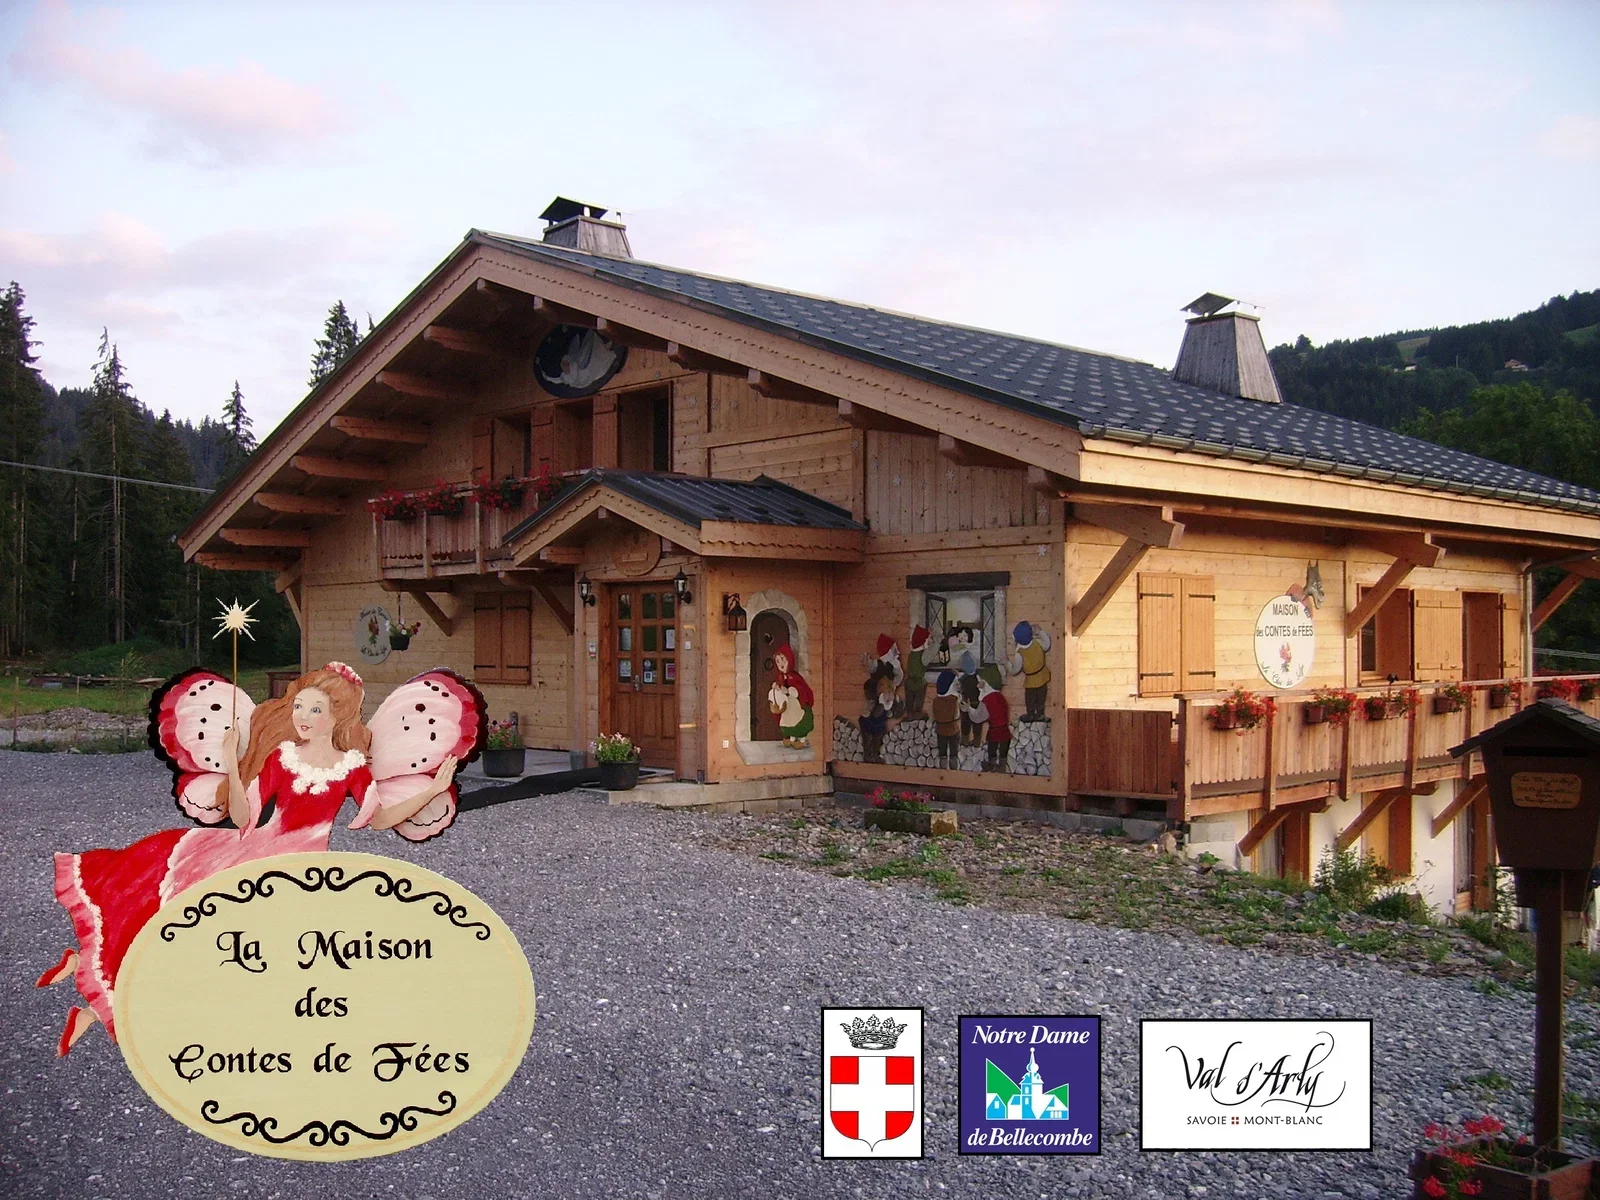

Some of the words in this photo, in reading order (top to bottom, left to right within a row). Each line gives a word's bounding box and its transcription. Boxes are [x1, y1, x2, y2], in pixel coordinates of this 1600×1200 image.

[1272, 603, 1299, 616] MAISON
[1256, 626, 1264, 637] des
[1264, 625, 1291, 637] CONTES
[1292, 626, 1298, 637] de
[1298, 622, 1314, 637] FÉES
